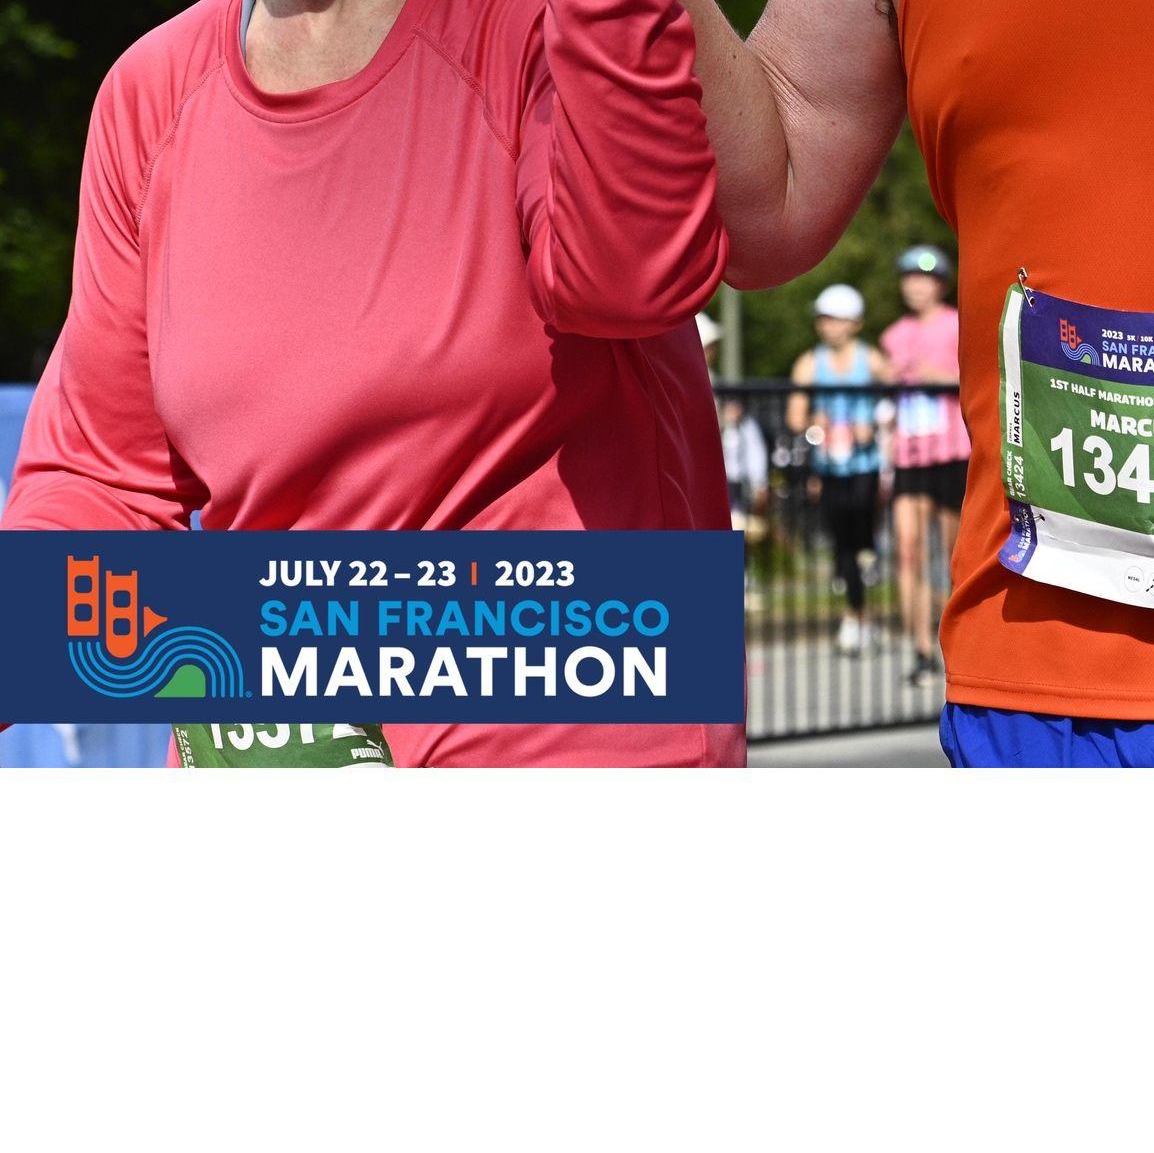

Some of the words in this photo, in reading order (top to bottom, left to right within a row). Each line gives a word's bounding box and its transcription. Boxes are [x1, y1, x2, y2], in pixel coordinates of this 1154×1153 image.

[1101, 328, 1124, 340] 2023
[1126, 334, 1136, 342] 5K
[1140, 335, 1154, 343] 10K
[1102, 340, 1128, 354] SAN
[1050, 378, 1069, 391] 1ST
[1071, 383, 1097, 398] HALF
[1013, 455, 1027, 499] 13424
[350, 747, 384, 760] PUMA
